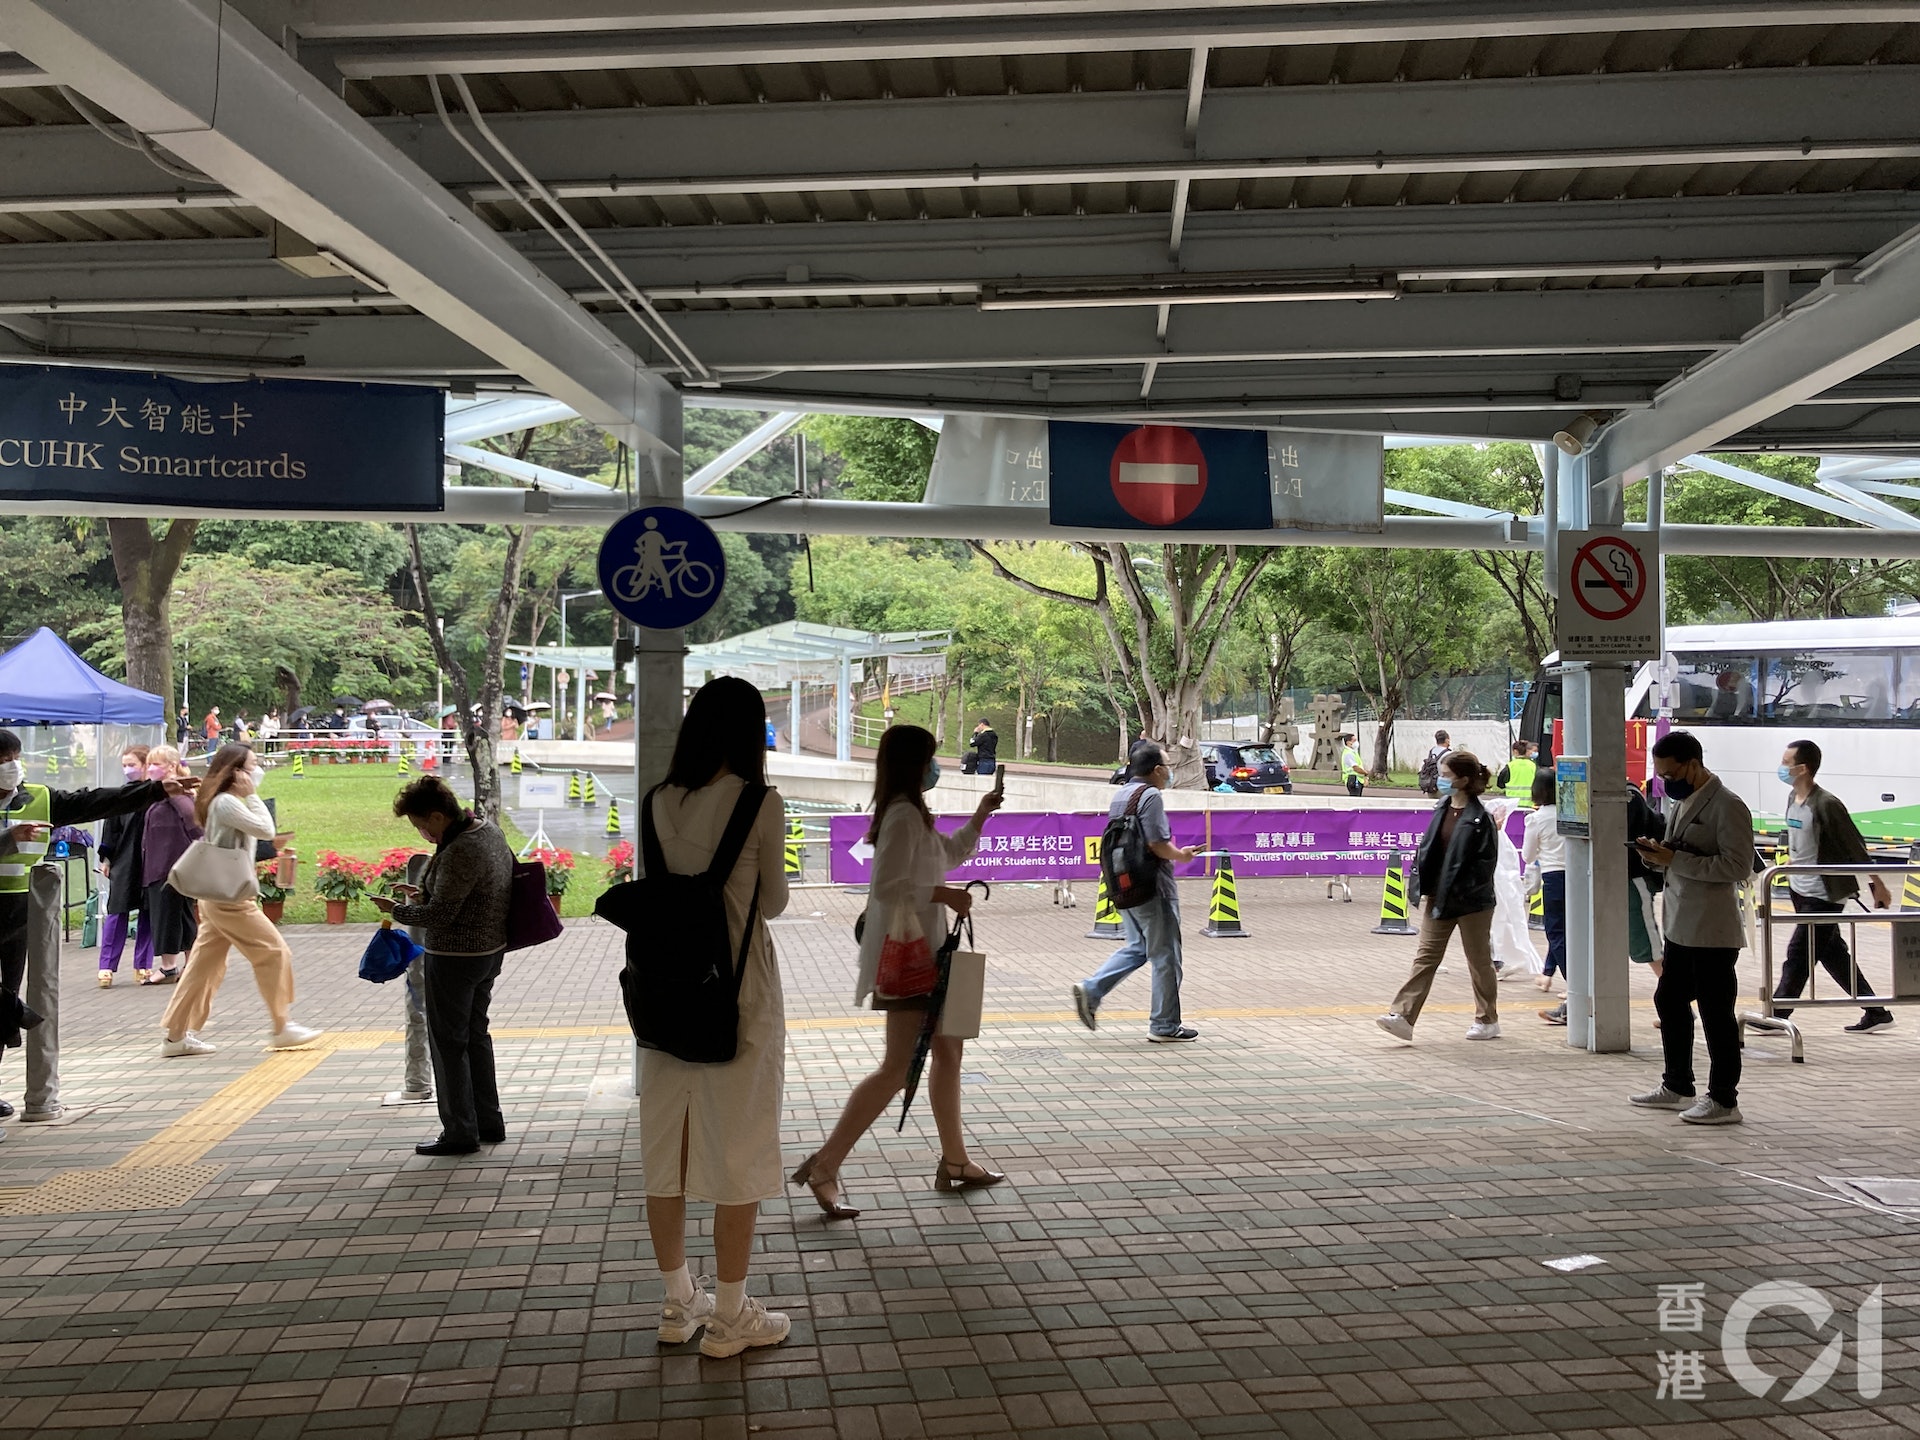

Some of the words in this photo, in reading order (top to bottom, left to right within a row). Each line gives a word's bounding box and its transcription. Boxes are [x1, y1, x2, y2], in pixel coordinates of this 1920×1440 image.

[59, 391, 253, 436] 中大智能卡
[0, 439, 105, 470] CUHK
[119, 446, 307, 480] Smartcards
[976, 835, 1074, 853] 員及學生校巴
[1255, 832, 1316, 848] 嘉賓專車
[974, 856, 1003, 867] CUHK
[1004, 855, 1046, 867] Students
[1048, 856, 1057, 866] &
[1058, 855, 1082, 866] Staff
[1297, 851, 1329, 861] Guests
